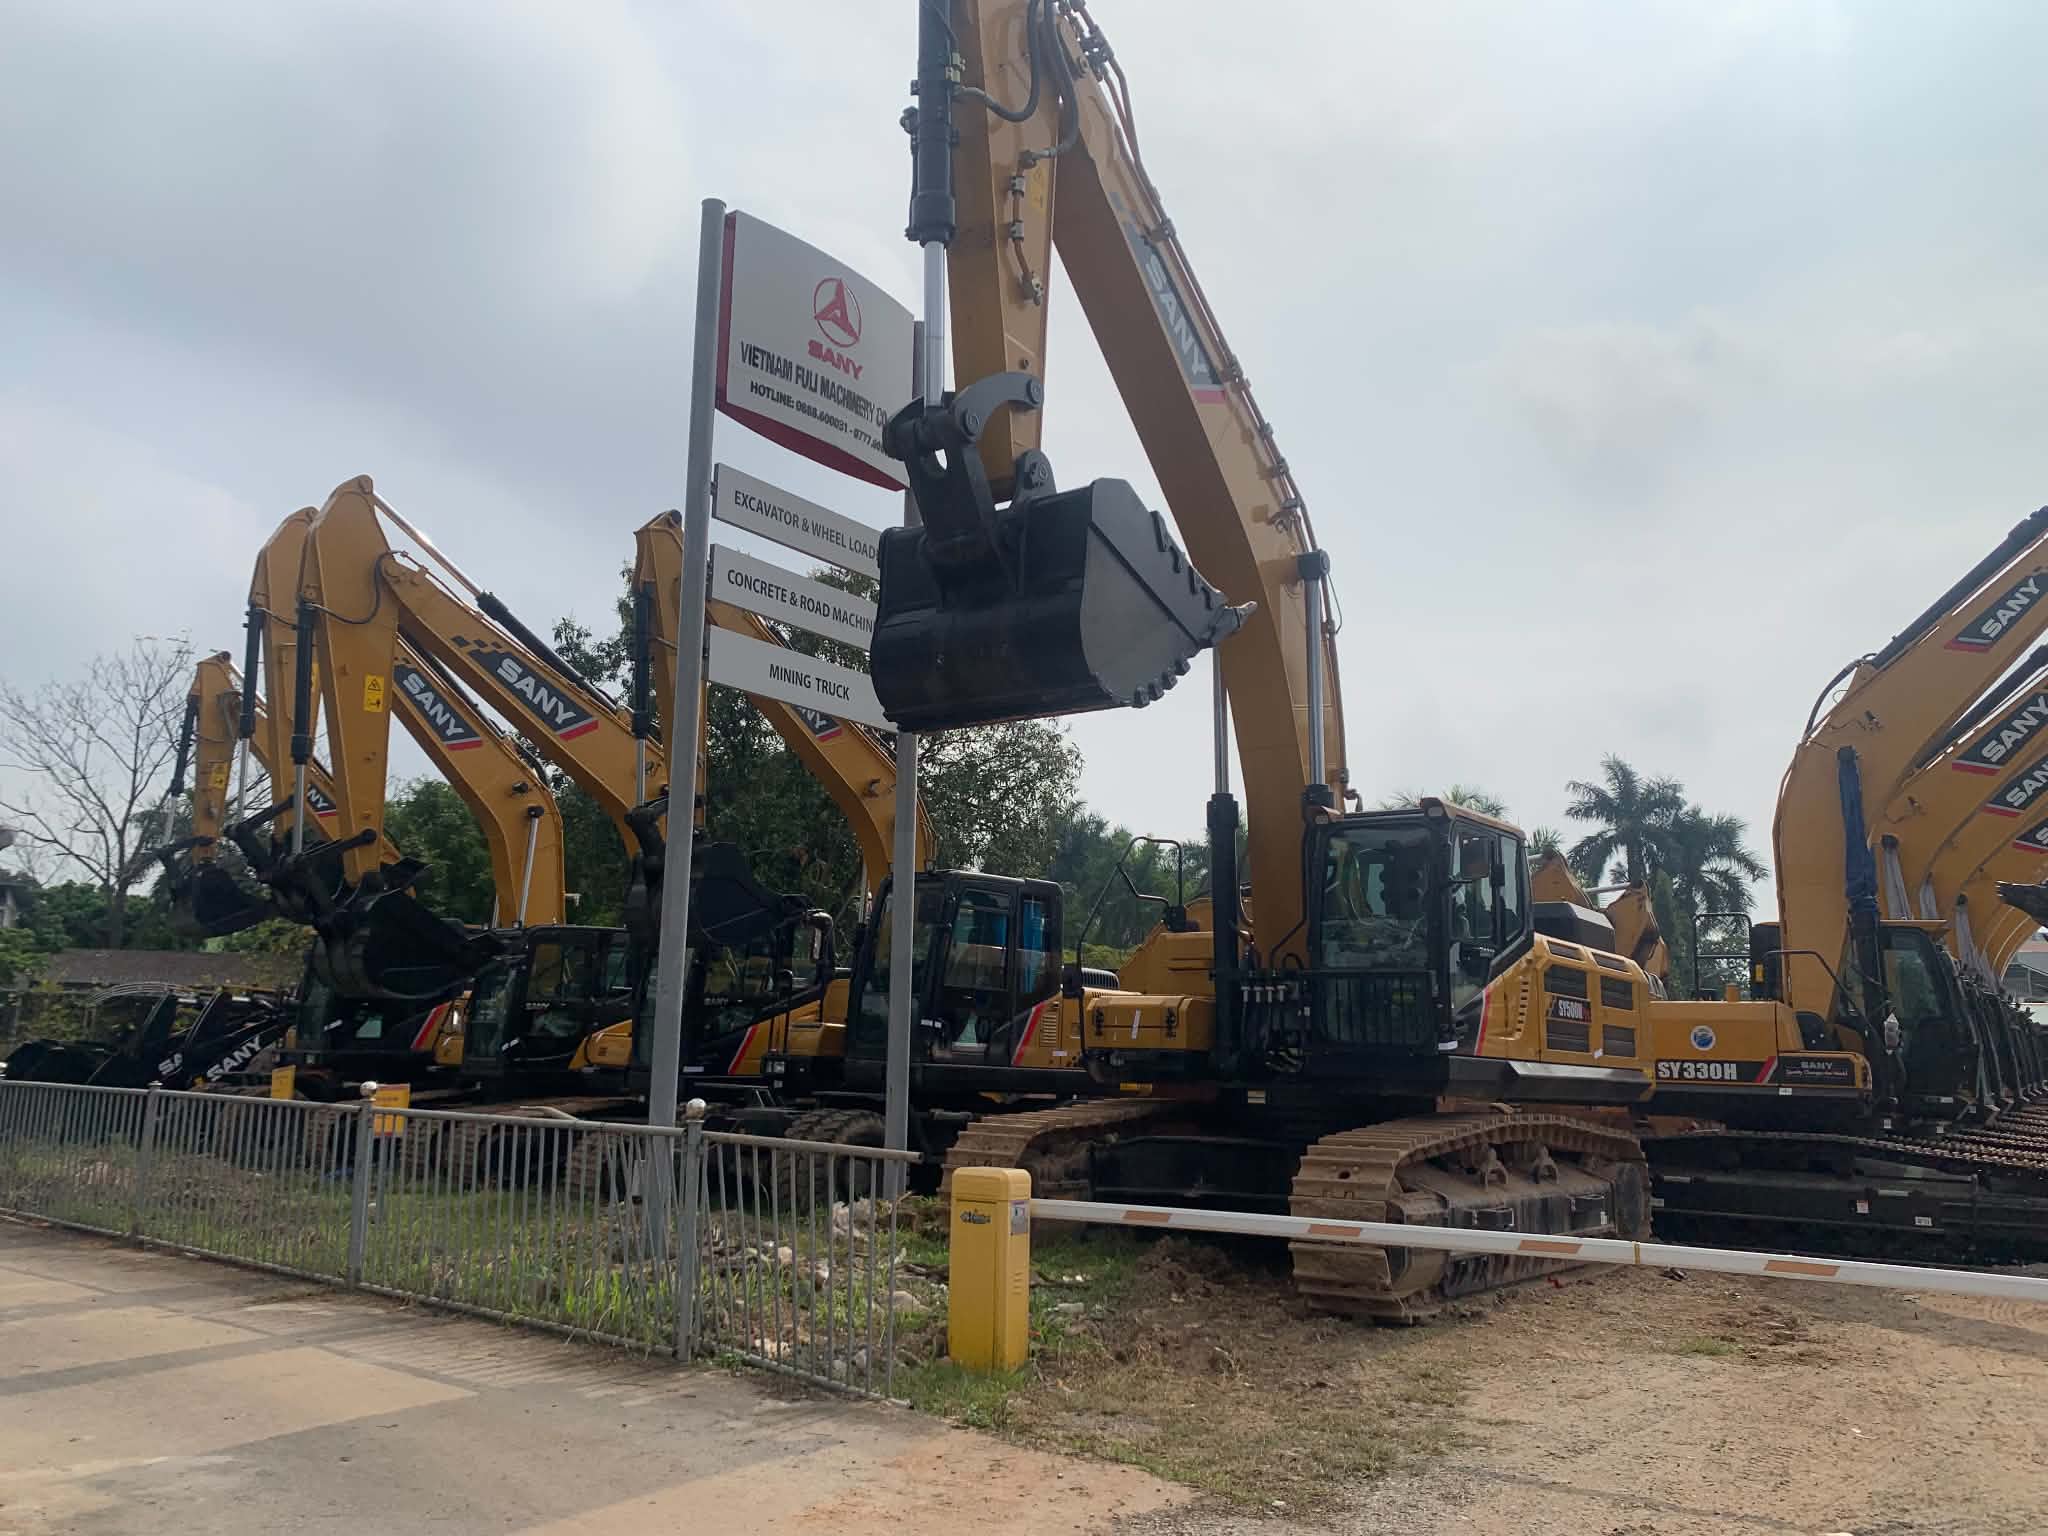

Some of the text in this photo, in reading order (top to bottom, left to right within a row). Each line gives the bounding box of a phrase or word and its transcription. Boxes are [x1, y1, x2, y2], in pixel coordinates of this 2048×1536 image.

[1145, 253, 1209, 375] SANY
[740, 340, 793, 382] VIETNAM
[795, 364, 818, 393] FULI
[820, 375, 875, 423] MACHINERY
[808, 339, 863, 380] SANY
[750, 380, 795, 409] HOTLINE:
[734, 489, 800, 529] EXCAVATOR
[801, 517, 810, 532] &
[811, 520, 847, 549] WHEEL
[727, 569, 787, 603] CONCRETE
[789, 591, 798, 607] &
[800, 594, 830, 618] ROAD
[1981, 577, 2040, 638] SANY
[402, 672, 465, 737] SANY
[496, 657, 577, 725] SANY
[769, 663, 850, 702] MINING TRUCK
[1982, 695, 2048, 762] SANY
[2006, 761, 2048, 807] SAN
[206, 1035, 261, 1081] SANY
[1657, 1061, 1737, 1081] SY330H
